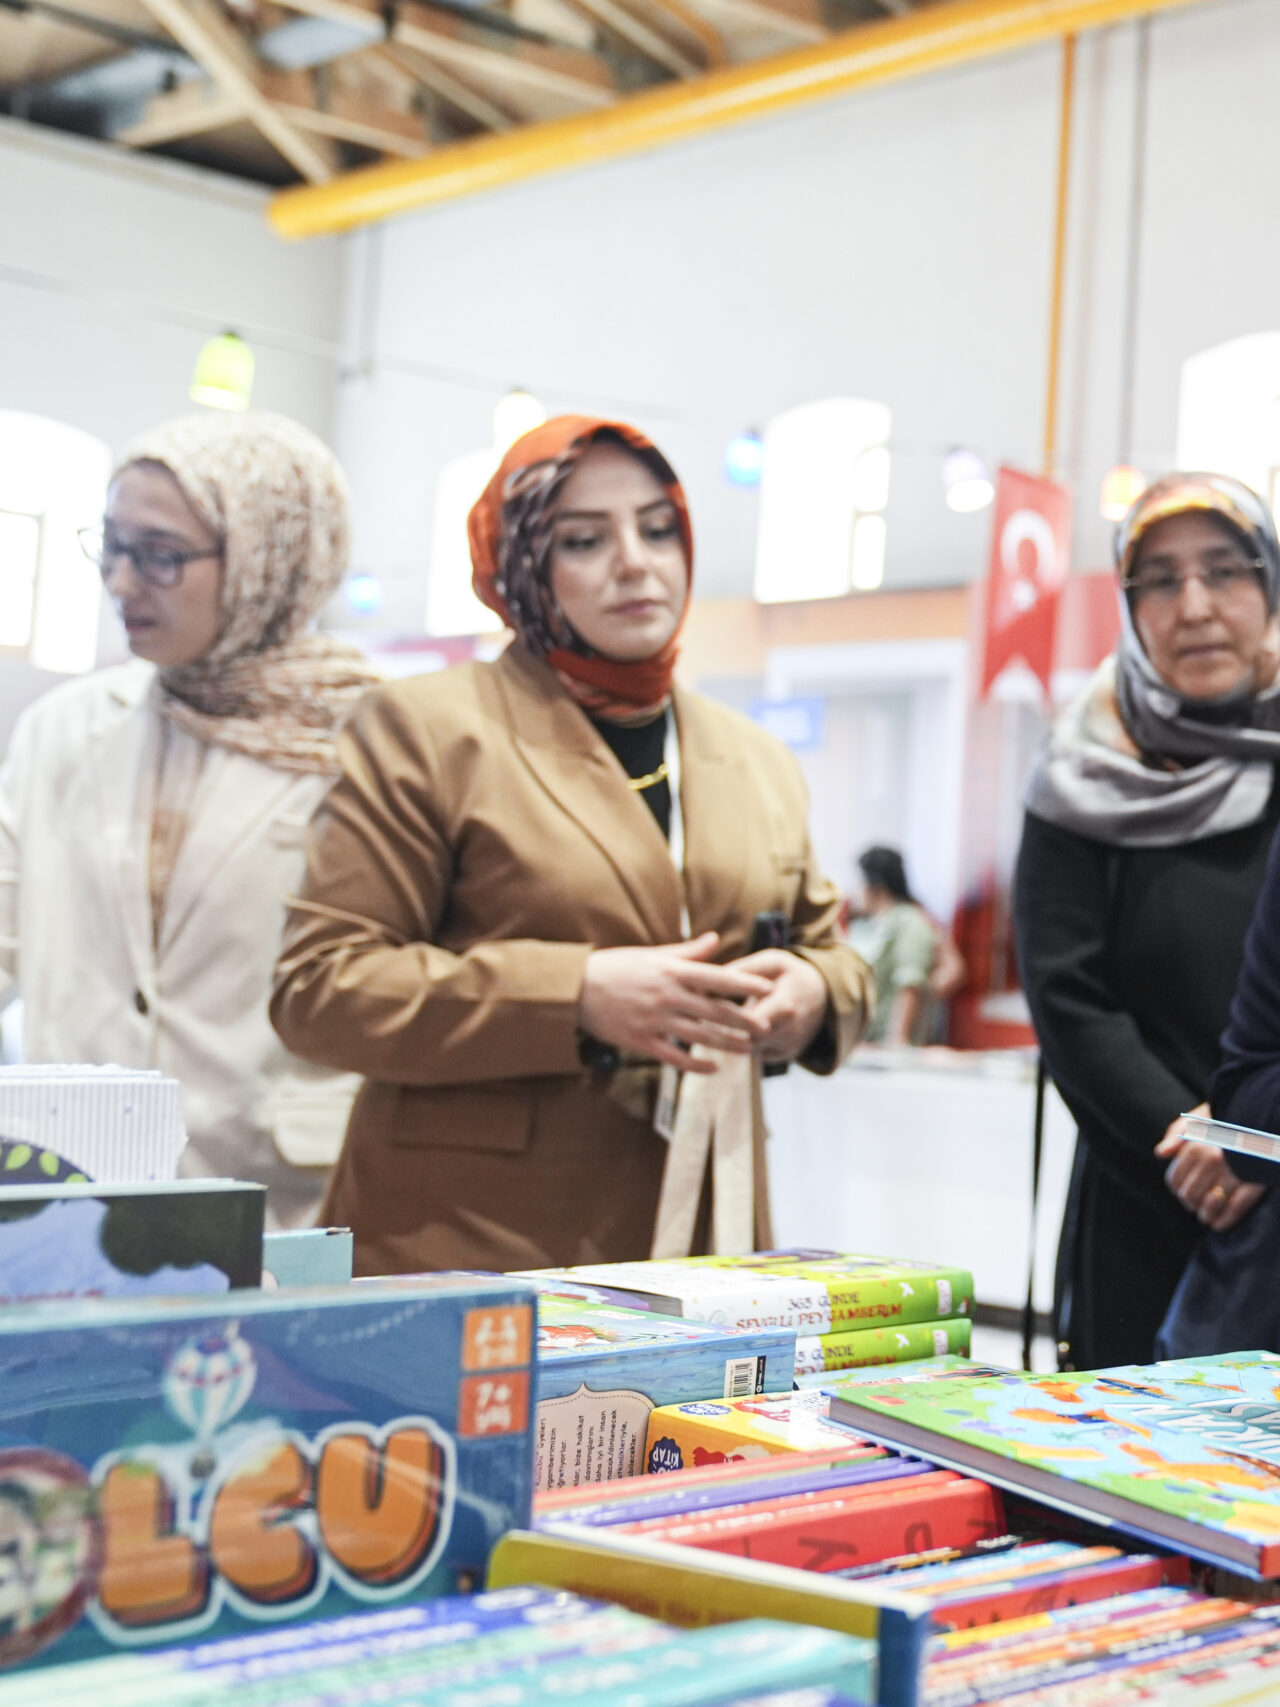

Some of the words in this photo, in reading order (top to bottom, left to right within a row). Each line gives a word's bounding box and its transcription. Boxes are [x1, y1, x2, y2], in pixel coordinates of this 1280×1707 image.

[547, 1428, 558, 1490] ygamberimizin
[607, 1409, 618, 1481] nacak/dinlenecek
[652, 1446, 680, 1468] KİTAP
